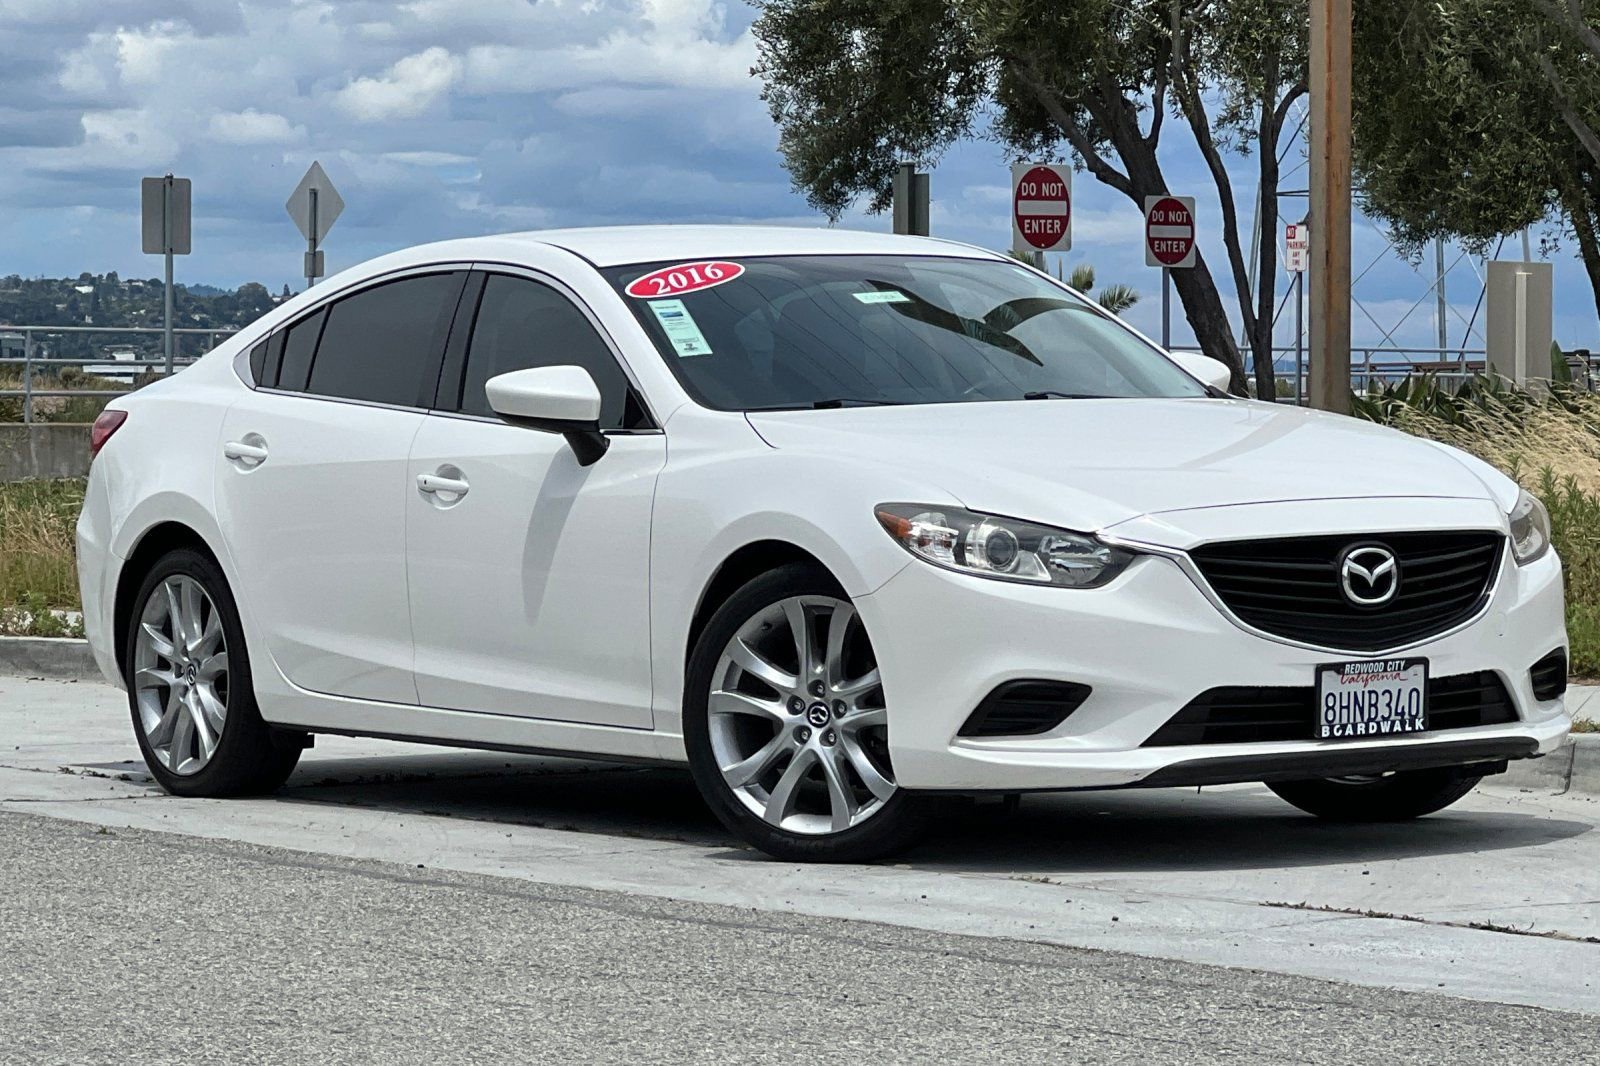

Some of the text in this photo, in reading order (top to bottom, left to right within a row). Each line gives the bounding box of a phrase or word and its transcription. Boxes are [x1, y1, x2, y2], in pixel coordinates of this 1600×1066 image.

[1021, 182, 1063, 197] DO NOT
[1152, 210, 1188, 223] DO NOT
[1024, 219, 1061, 234] ENTER
[1154, 240, 1186, 253] ENTER
[648, 263, 724, 295] 2016
[1345, 660, 1406, 675] REDWOOD CITY
[1340, 672, 1408, 688] California
[1324, 687, 1420, 724] 8HNB340
[1321, 718, 1425, 738] BOARDWALK
